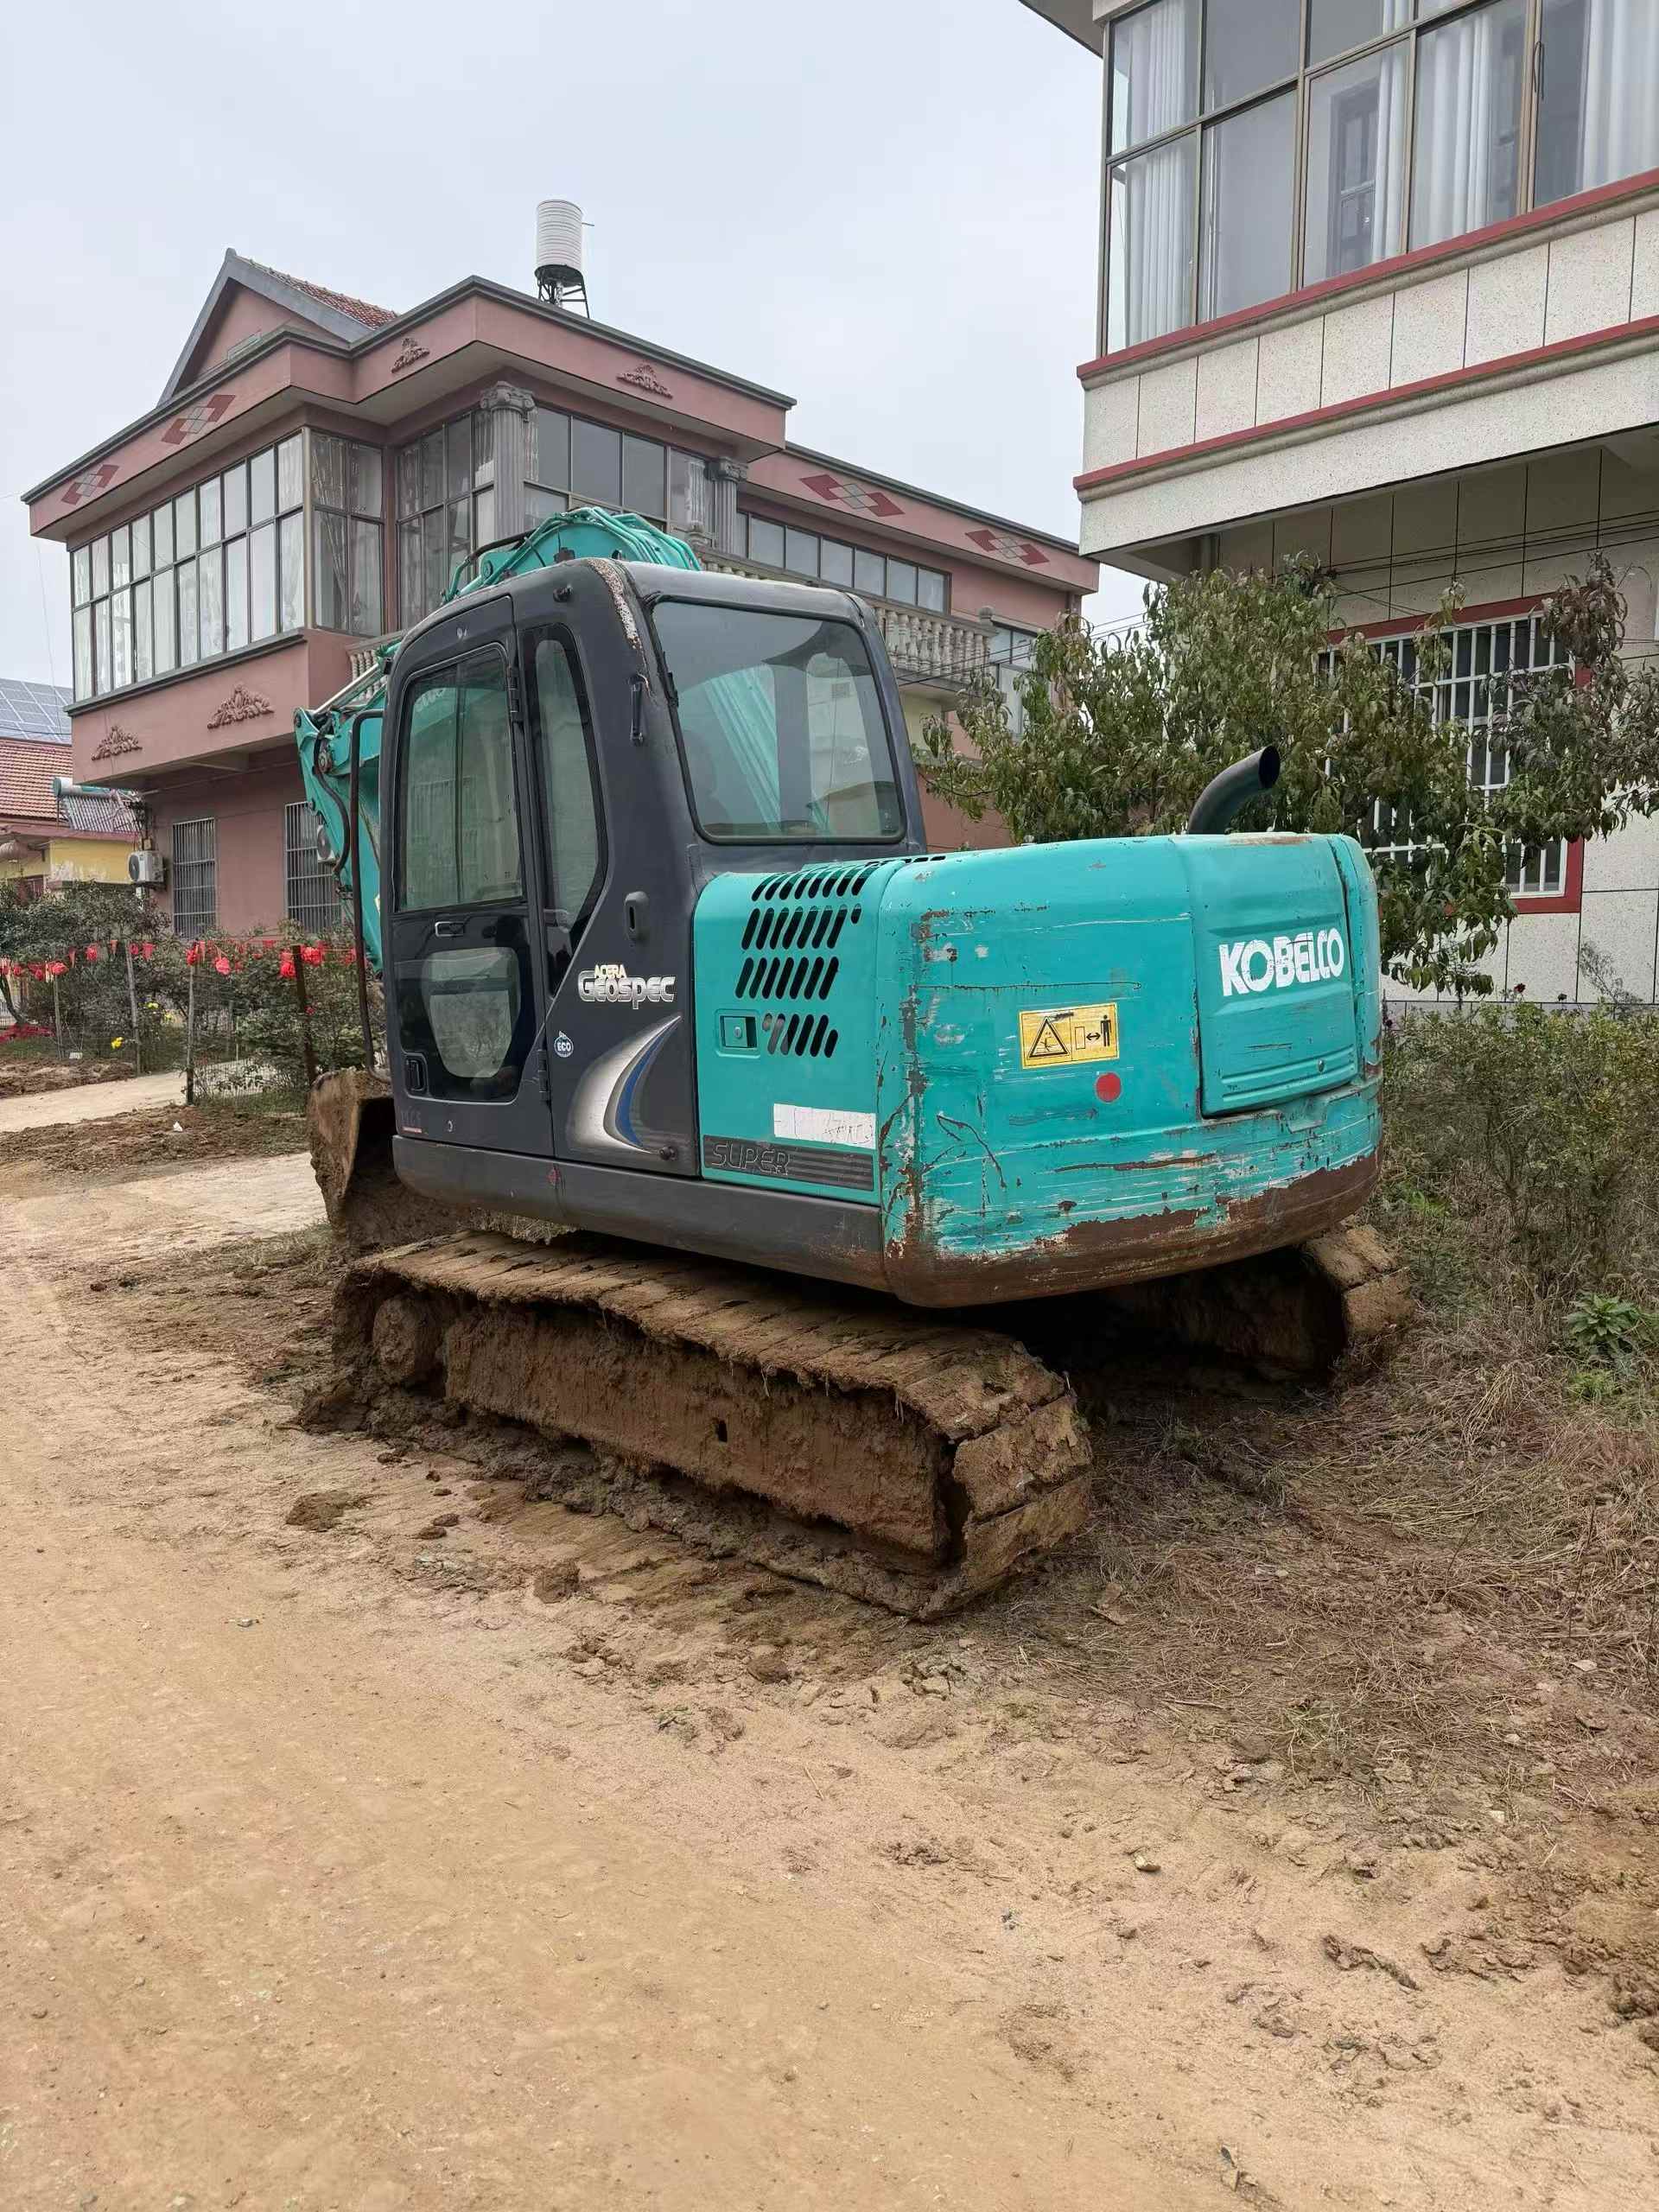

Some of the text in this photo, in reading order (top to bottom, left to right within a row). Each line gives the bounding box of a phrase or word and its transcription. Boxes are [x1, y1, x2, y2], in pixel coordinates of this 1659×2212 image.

[594, 964, 627, 979] ACERA
[1219, 927, 1344, 996] KOBELCO
[557, 1041, 571, 1053] ECO
[711, 1141, 791, 1176] SUPER
